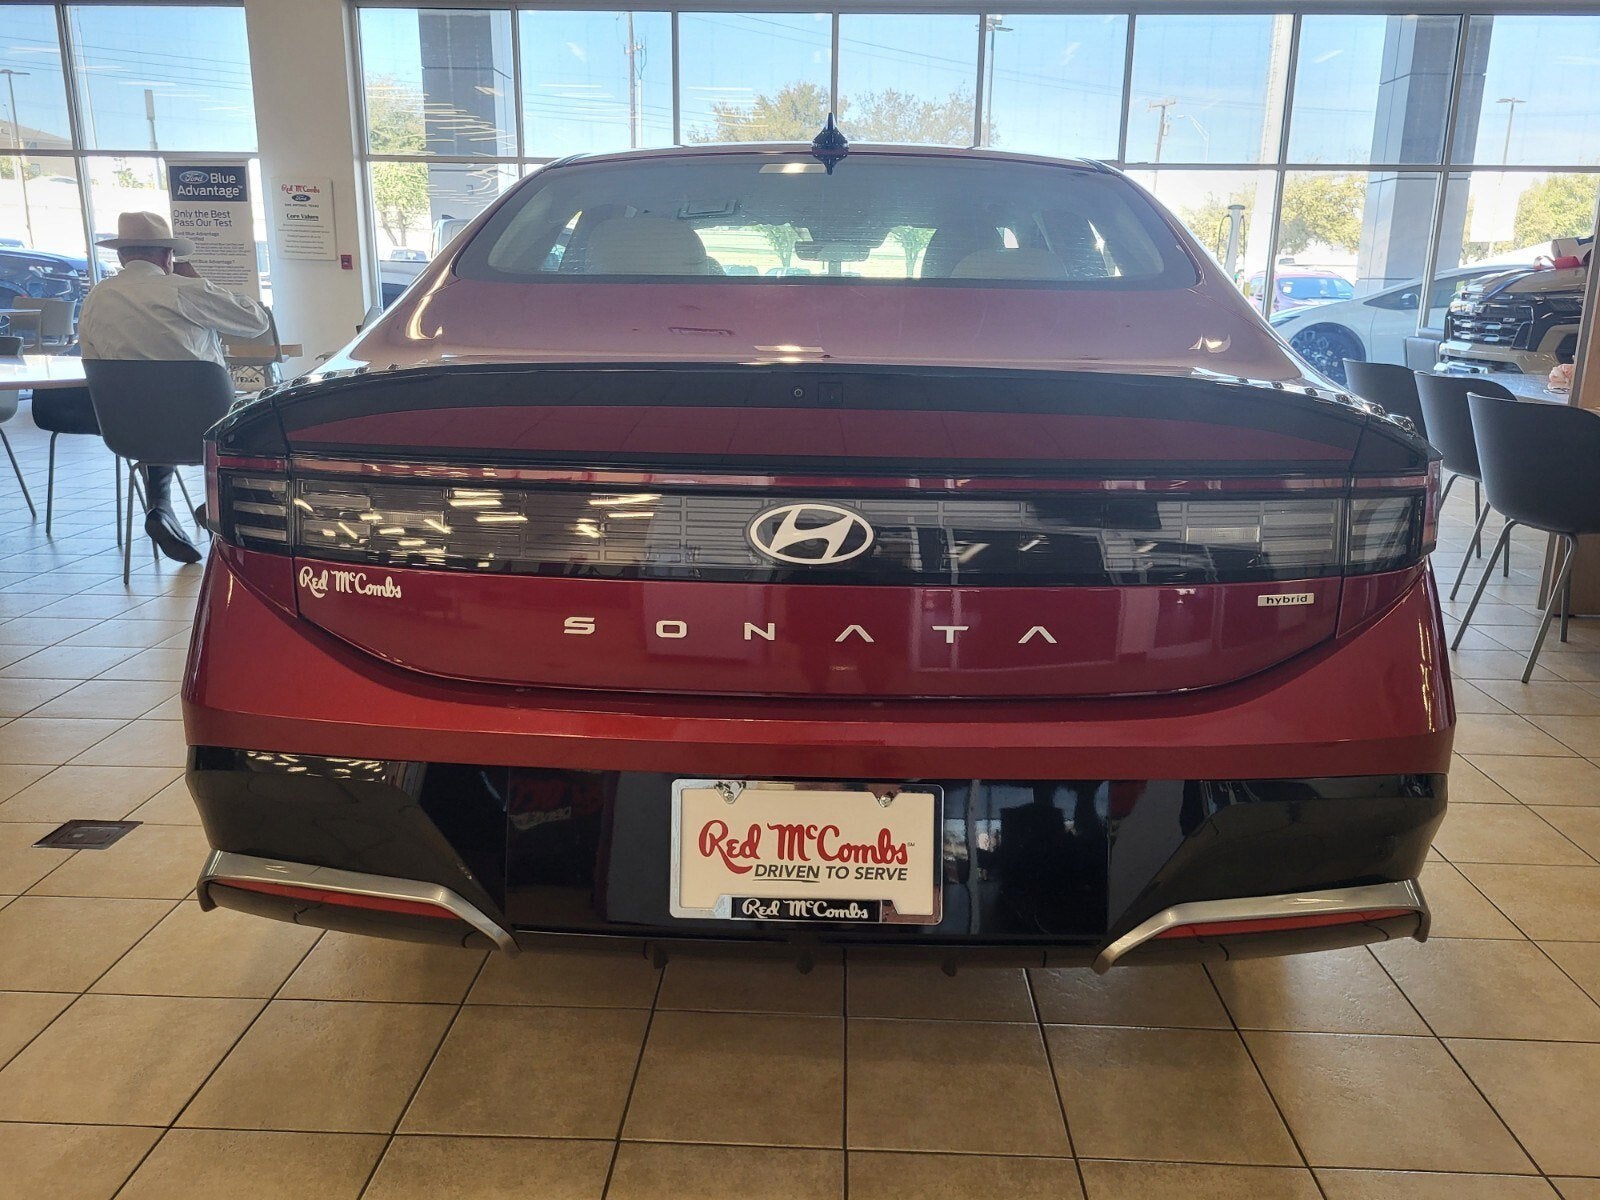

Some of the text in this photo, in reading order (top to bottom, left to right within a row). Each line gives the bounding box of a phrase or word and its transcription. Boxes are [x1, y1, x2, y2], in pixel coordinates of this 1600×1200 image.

[184, 173, 204, 182] Ford
[210, 173, 236, 184] Blue
[281, 184, 320, 195] Red McCombs
[173, 209, 231, 219] Only the Best
[196, 219, 212, 227] Our
[214, 219, 232, 227] Test
[299, 566, 402, 599] Red McCombs
[1266, 594, 1308, 605] hybrid
[563, 616, 1058, 644] SONATA
[698, 819, 762, 875] Red
[767, 822, 908, 865] McCombs
[754, 864, 908, 881] DRIVEN TO SERVE
[741, 898, 869, 919] Red McCombs
